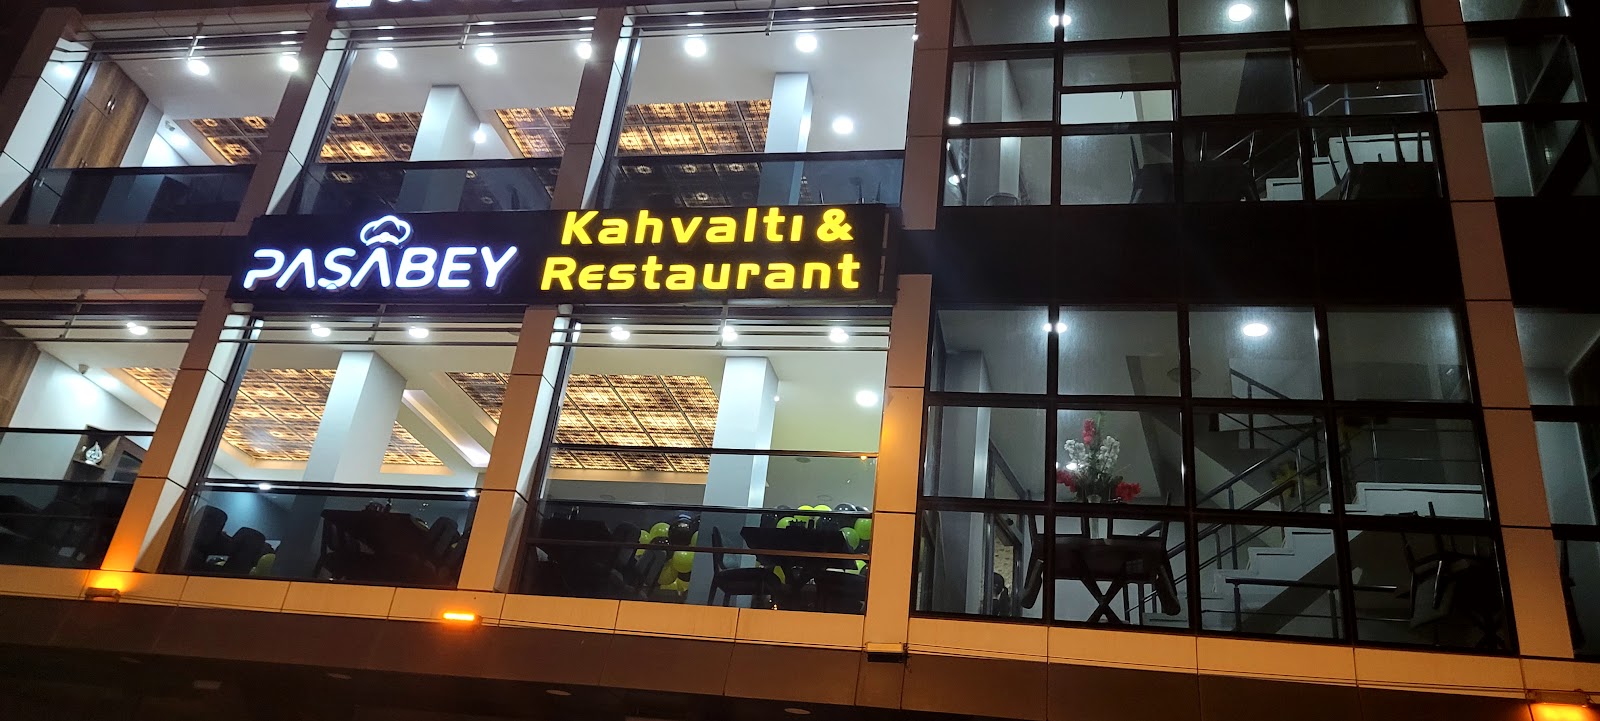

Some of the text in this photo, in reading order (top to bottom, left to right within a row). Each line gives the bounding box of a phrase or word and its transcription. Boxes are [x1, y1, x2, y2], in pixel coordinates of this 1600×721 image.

[560, 206, 854, 245] Kahvaltı &
[540, 253, 861, 291] Restaurant
